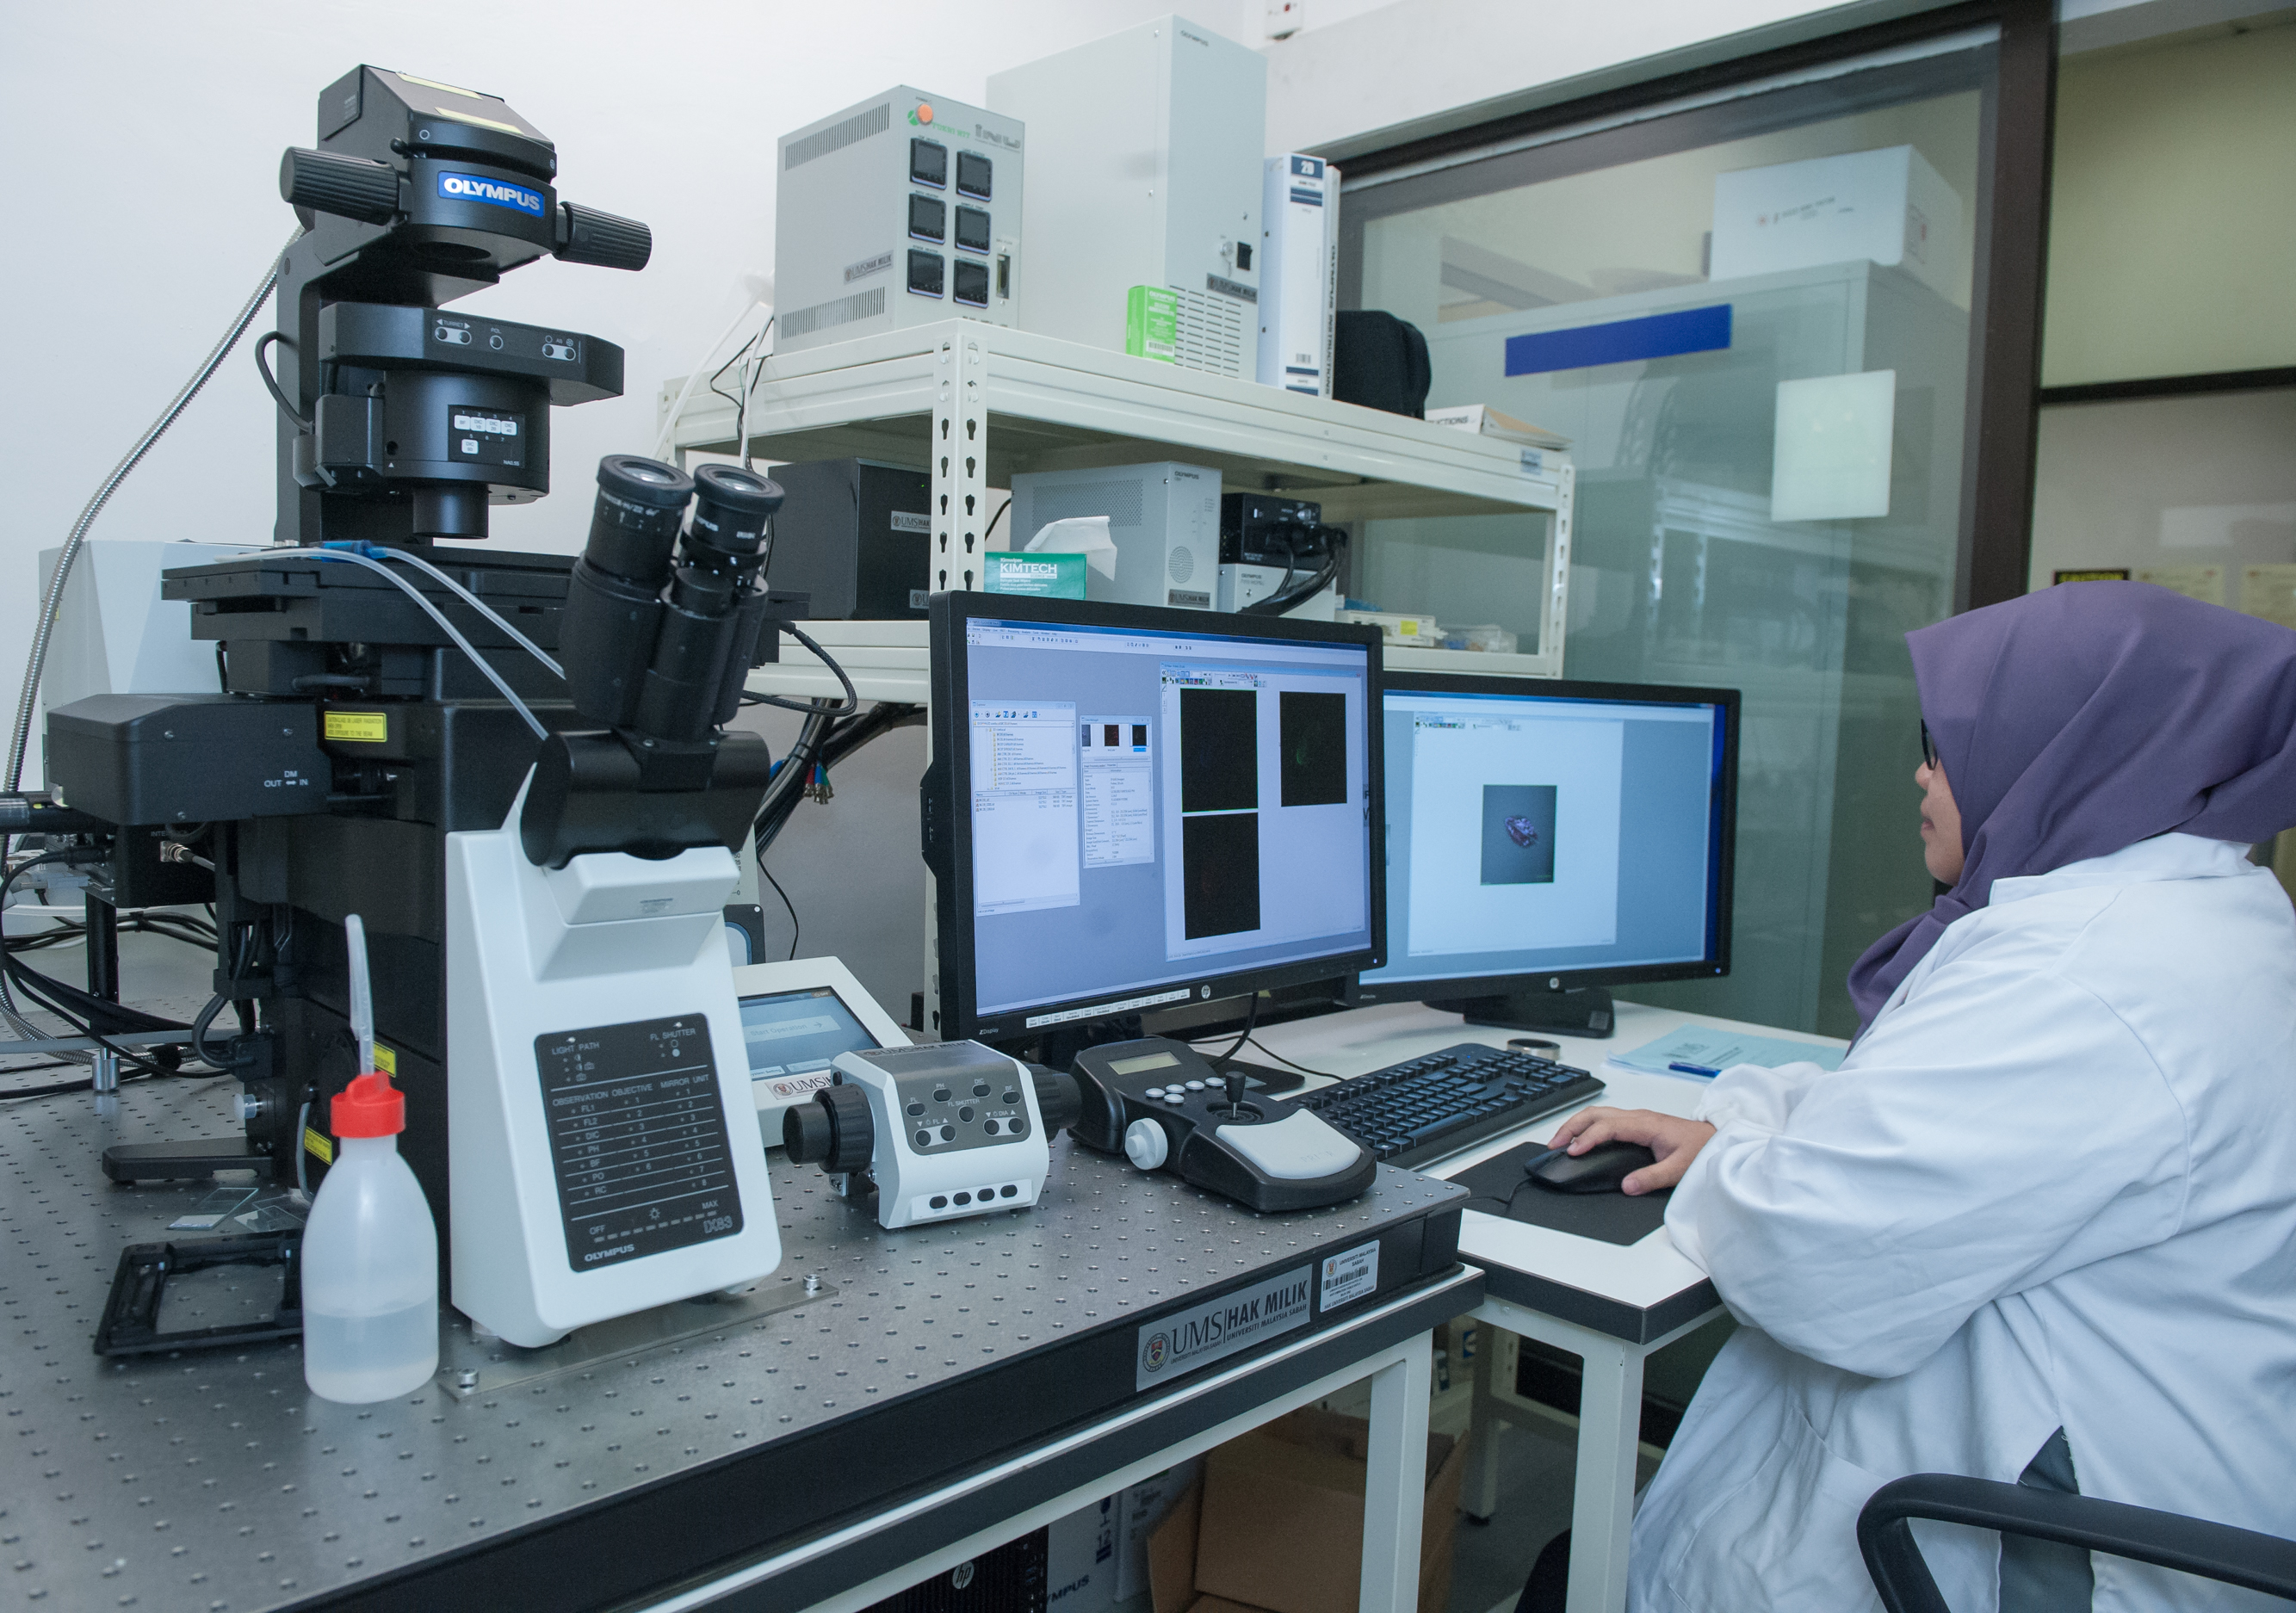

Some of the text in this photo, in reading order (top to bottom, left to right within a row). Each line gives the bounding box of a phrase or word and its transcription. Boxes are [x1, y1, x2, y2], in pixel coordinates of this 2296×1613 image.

[444, 177, 540, 210] OLYMPUS
[1174, 471, 1199, 479] OLYMPUS
[901, 516, 918, 526] UMS
[1000, 563, 1057, 573] KIMTECH
[263, 779, 282, 788] OUT
[662, 1029, 696, 1039] SHUTTER
[770, 1023, 808, 1034] Operation
[552, 1042, 599, 1055] LIGHT PATH
[789, 1076, 825, 1091] UMS
[553, 1074, 709, 1107] OBSERVATION OBJECTIVE MIRROR UNIT
[584, 1117, 597, 1126] FL2
[585, 1131, 600, 1140] DIC
[587, 1145, 600, 1154] PH
[590, 1159, 600, 1168] BF
[595, 1186, 607, 1195] RC
[702, 1200, 718, 1209] MAX
[589, 1224, 606, 1235] OFF
[703, 1215, 733, 1233] IX83
[585, 1244, 634, 1262] OLYMPUS
[1340, 1248, 1376, 1265] UNIVERSITI MALAYSIA
[1228, 1298, 1260, 1330] HAK
[1264, 1280, 1308, 1315] MILIK
[1227, 1304, 1307, 1341] UNIVERSITI MALAYSIA SABAH
[1172, 1311, 1222, 1354] UMS
[1171, 1352, 1191, 1364] UNIVERSITI
[1191, 1345, 1210, 1357] MALAYSIA
[955, 1562, 973, 1589] hp
[1047, 1574, 1090, 1604] YMPUS
